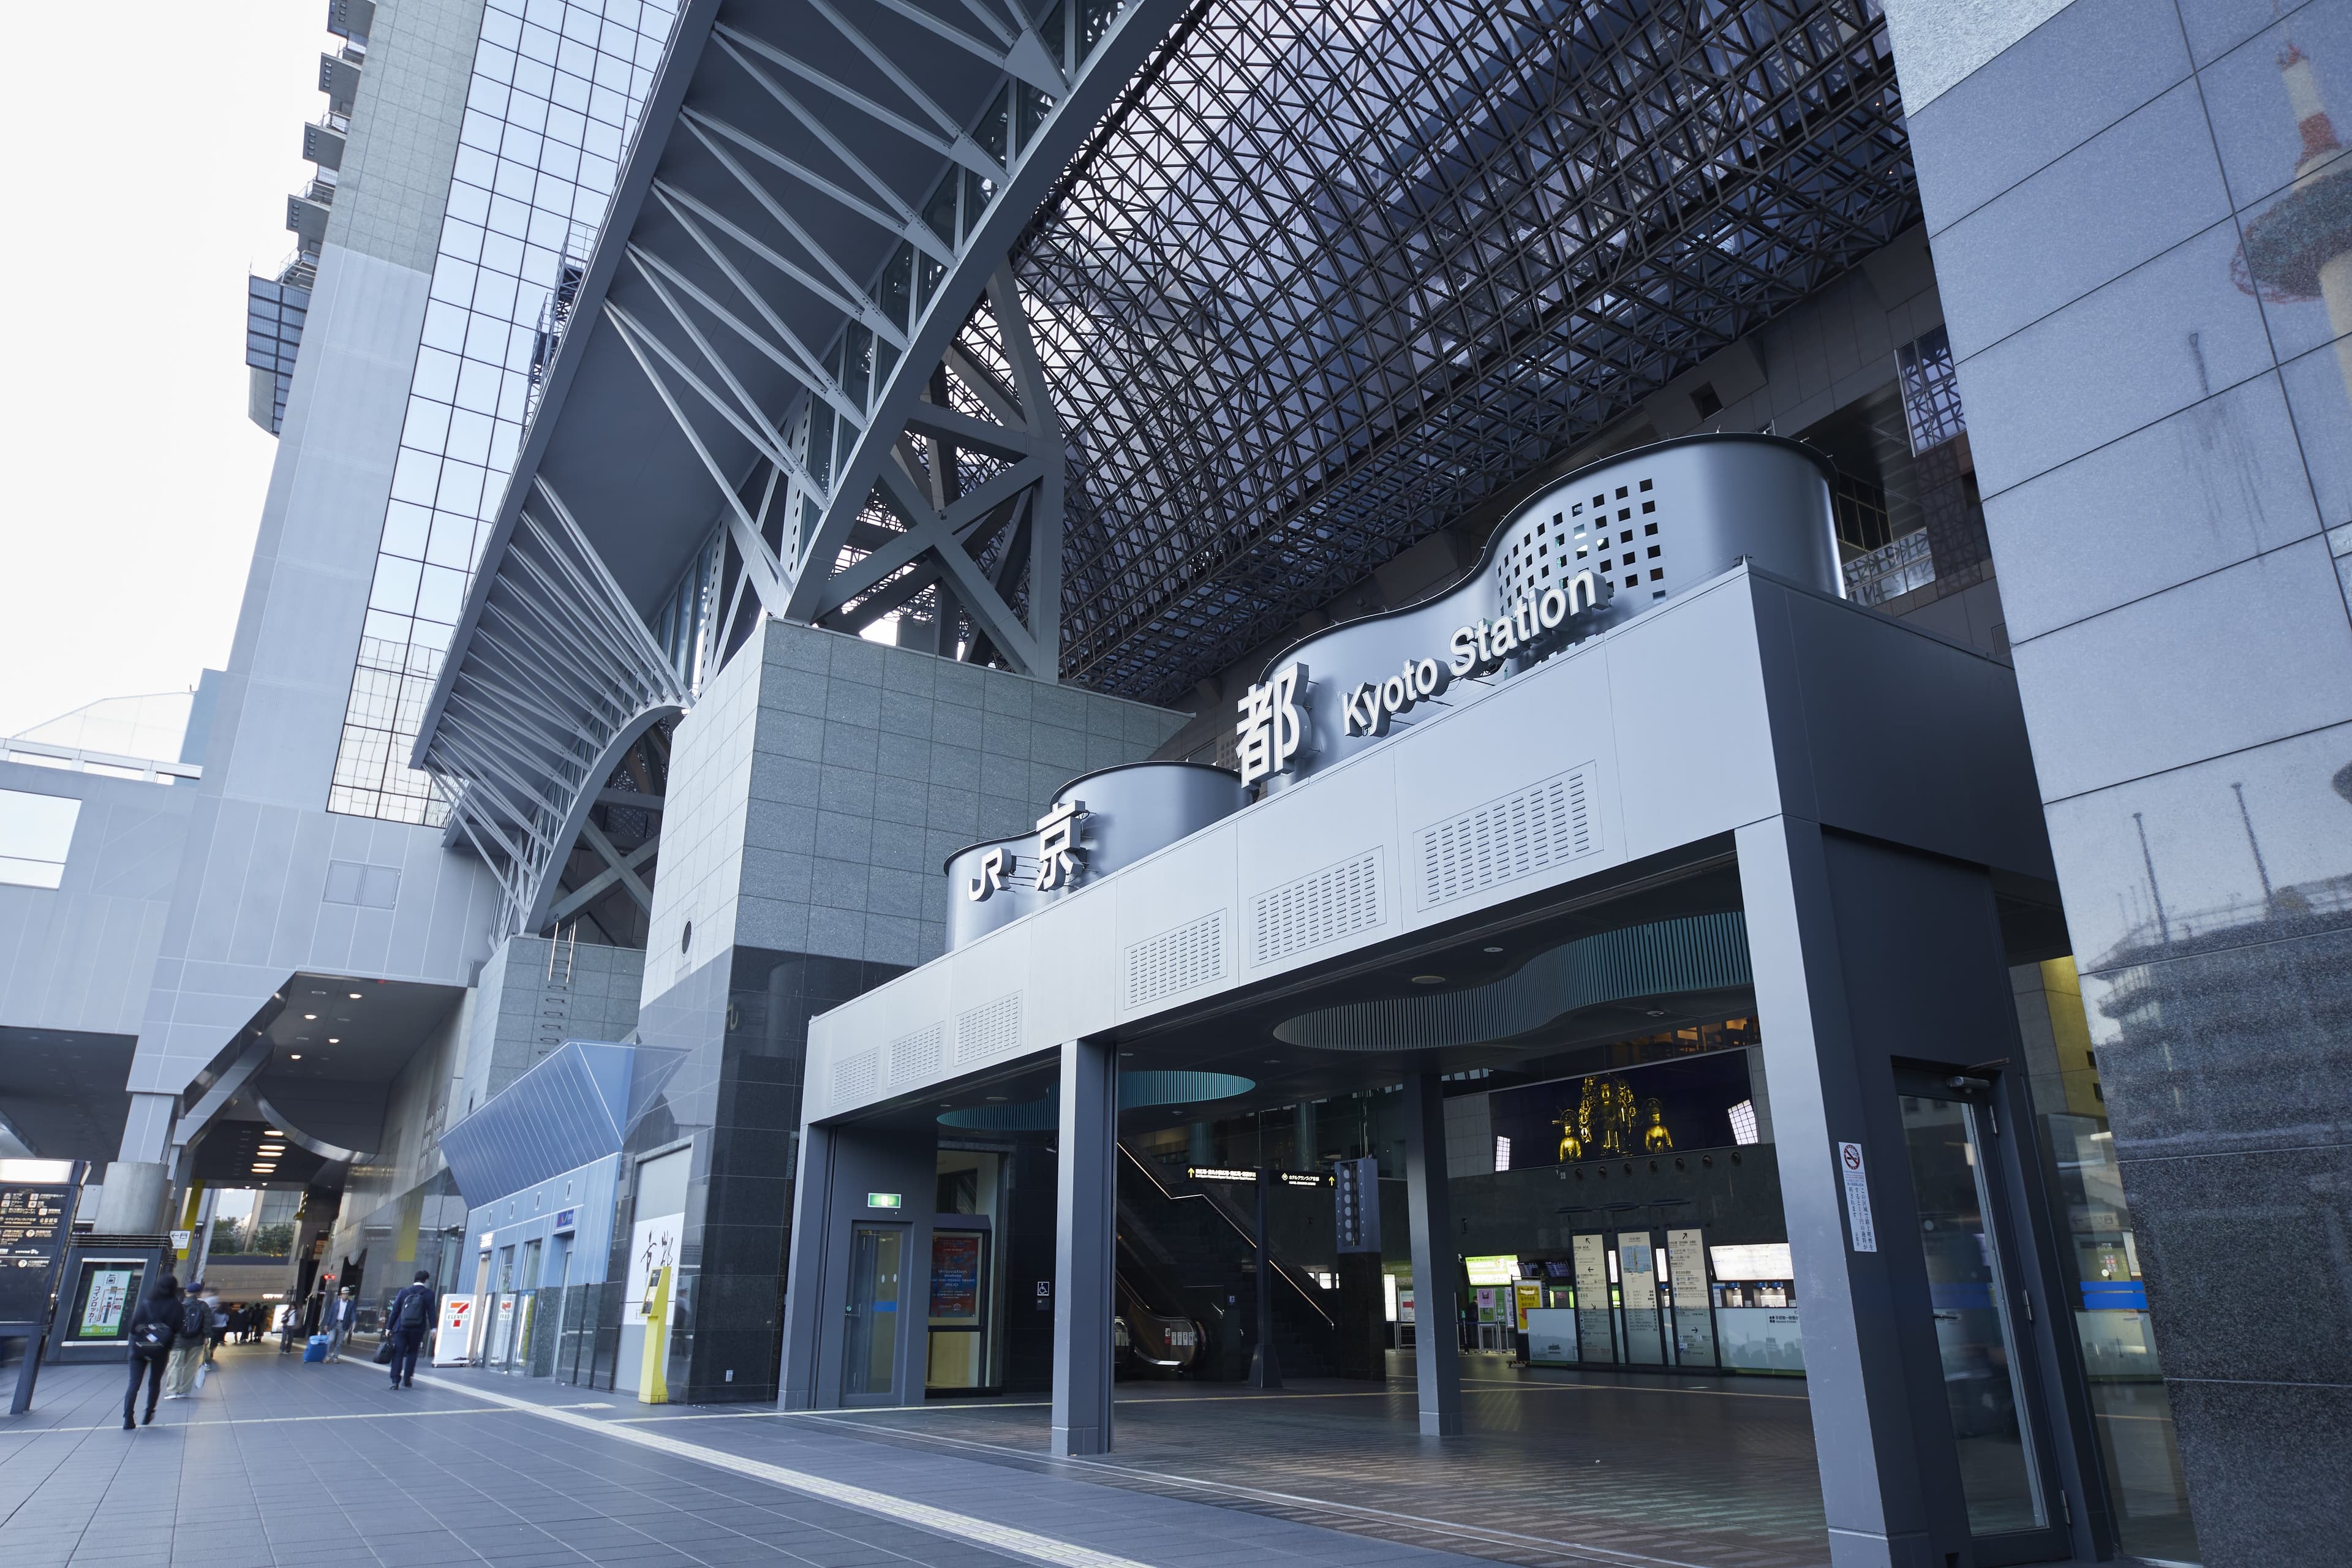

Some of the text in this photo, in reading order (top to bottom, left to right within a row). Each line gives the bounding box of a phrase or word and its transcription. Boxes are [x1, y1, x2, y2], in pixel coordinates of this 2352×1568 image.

[1342, 569, 1597, 737] Kyoto Station
[968, 846, 1003, 902] JR
[88, 1286, 100, 1323] コインロッカー
